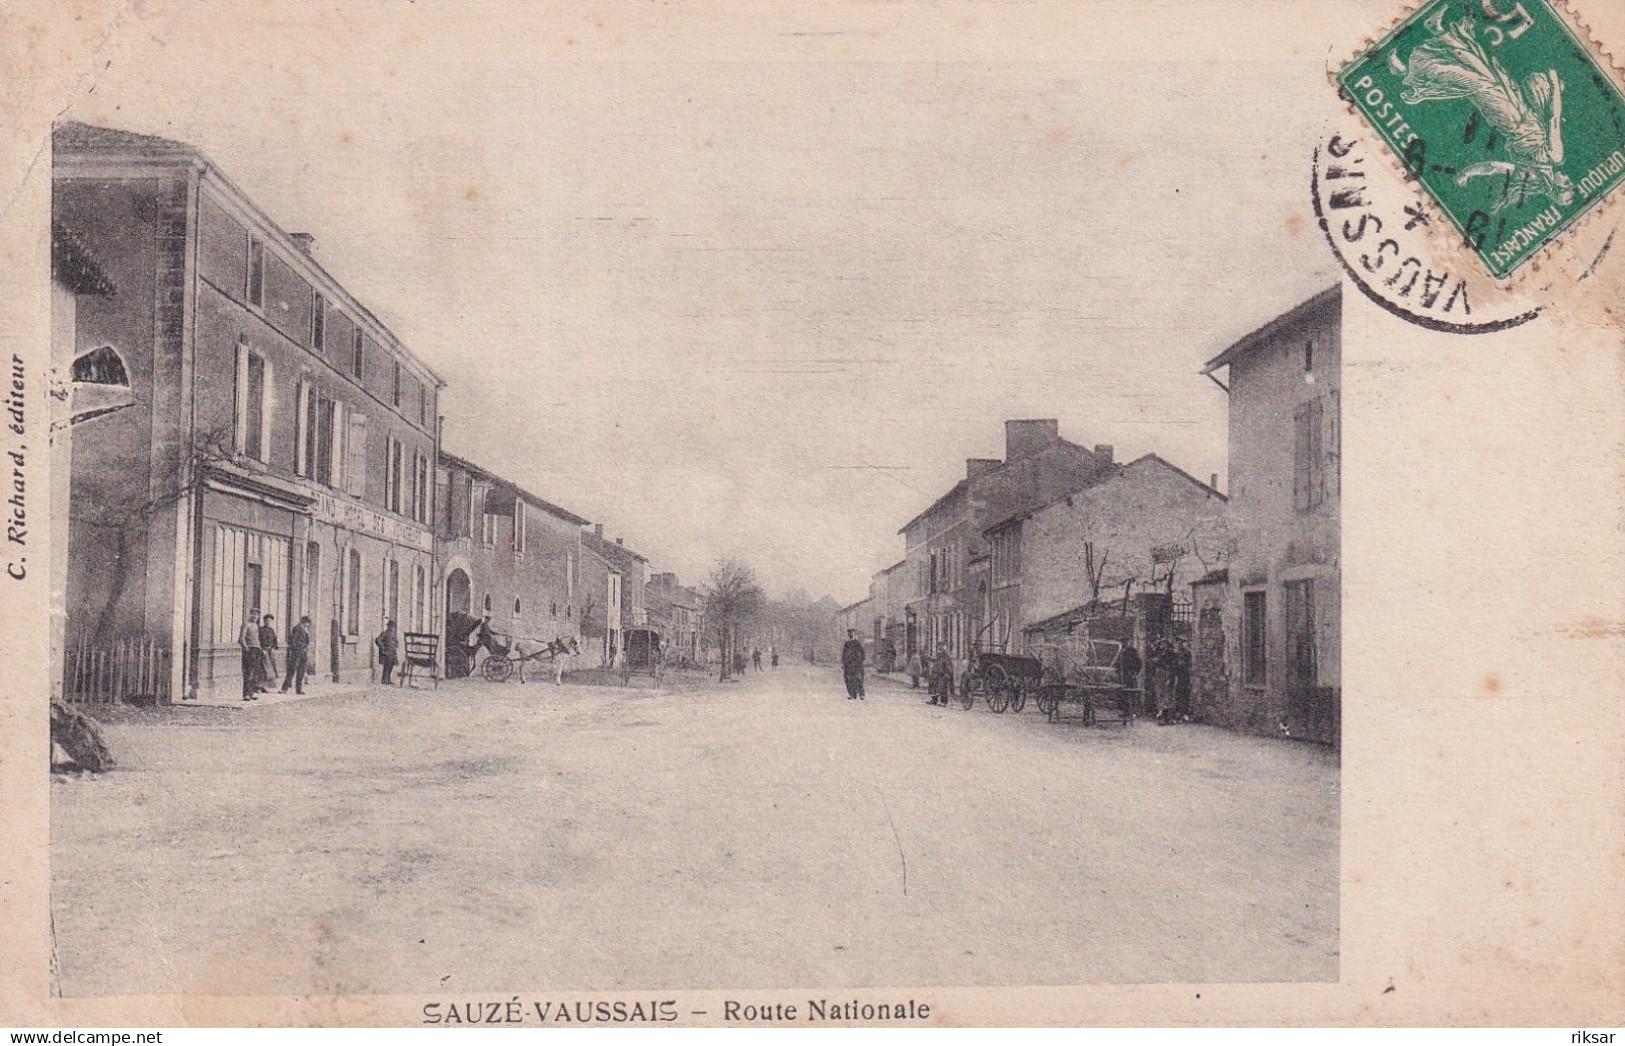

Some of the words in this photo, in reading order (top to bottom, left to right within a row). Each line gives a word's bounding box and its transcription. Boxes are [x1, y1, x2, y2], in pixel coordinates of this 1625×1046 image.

[1354, 75, 1419, 149] POSTES
[6, 353, 25, 436] éditeur
[7, 443, 28, 546] Richard,
[7, 556, 28, 581] C.
[422, 995, 679, 1024] SAUZÉ-VAUSSAIS
[723, 1000, 798, 1021] Route
[807, 999, 931, 1020] Nationale
